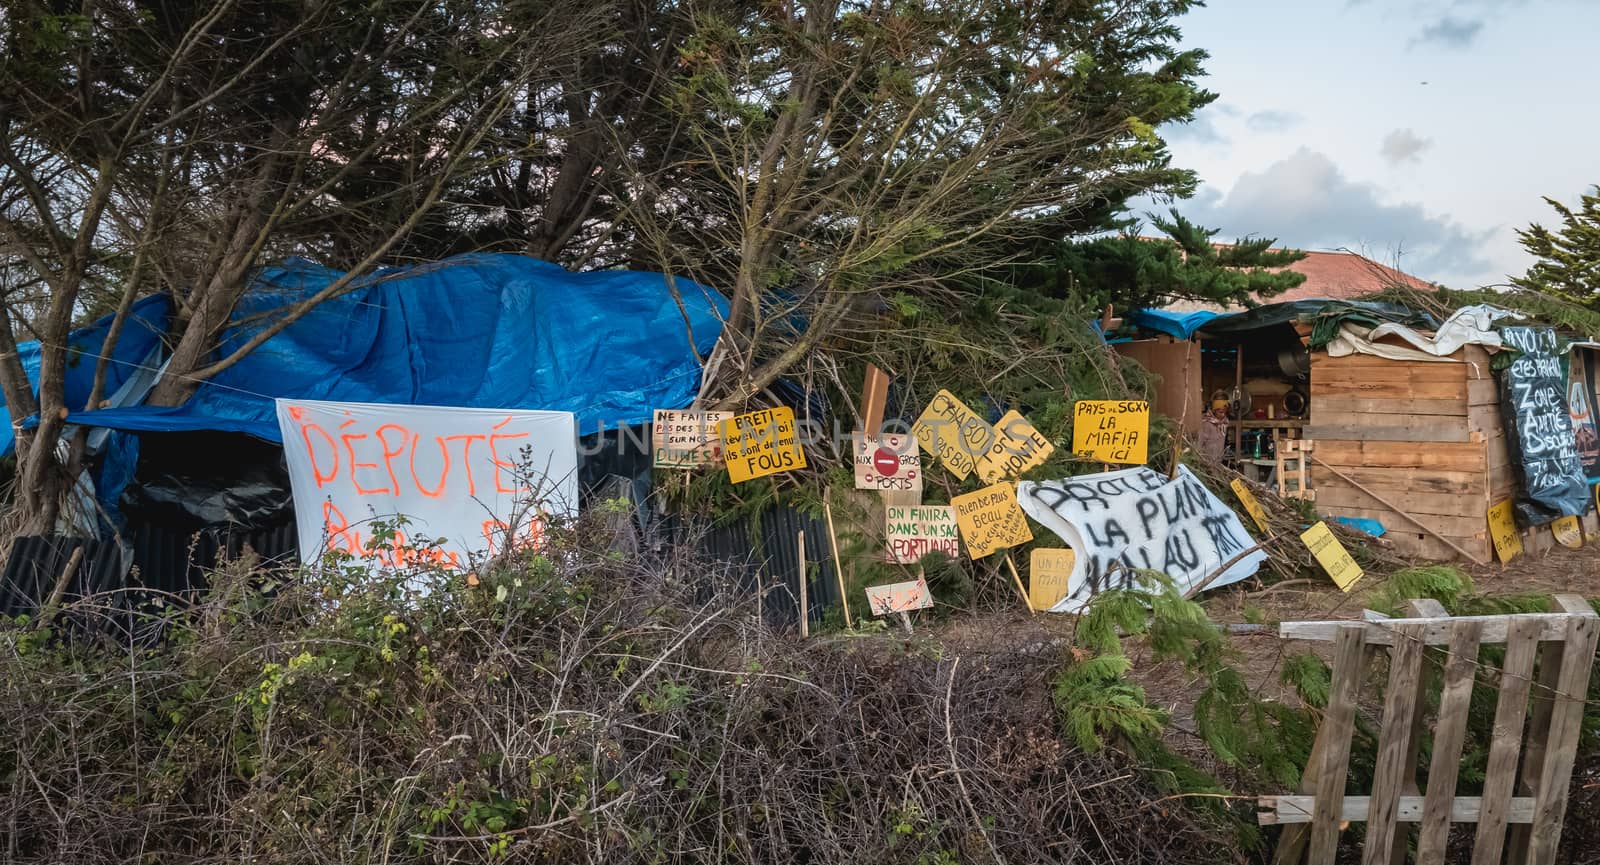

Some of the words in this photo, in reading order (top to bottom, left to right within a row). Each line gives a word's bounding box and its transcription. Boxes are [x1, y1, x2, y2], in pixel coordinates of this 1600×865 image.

[1078, 402, 1106, 416] PAYS
[657, 411, 675, 422] NE
[680, 411, 720, 423] FAITES
[1099, 416, 1116, 430] LA
[656, 425, 673, 434] PAS
[675, 425, 693, 433] DES
[669, 435, 687, 443] SUR
[689, 435, 708, 443] NOS
[301, 415, 530, 497] DÉPUTÉ
[740, 444, 761, 459] sont
[1001, 431, 1046, 475] HONTE
[747, 450, 794, 476] FOUS
[856, 455, 872, 465] AUX
[899, 454, 921, 467] GROS
[874, 475, 913, 490] PORTS
[888, 507, 904, 519] ON
[910, 508, 951, 521] FINIRA
[888, 522, 919, 536] DANS
[923, 523, 938, 537] UN
[940, 524, 958, 538] SAC
[1085, 518, 1129, 548] LA
[1163, 528, 1199, 575] AU
[1038, 558, 1052, 569] UN
